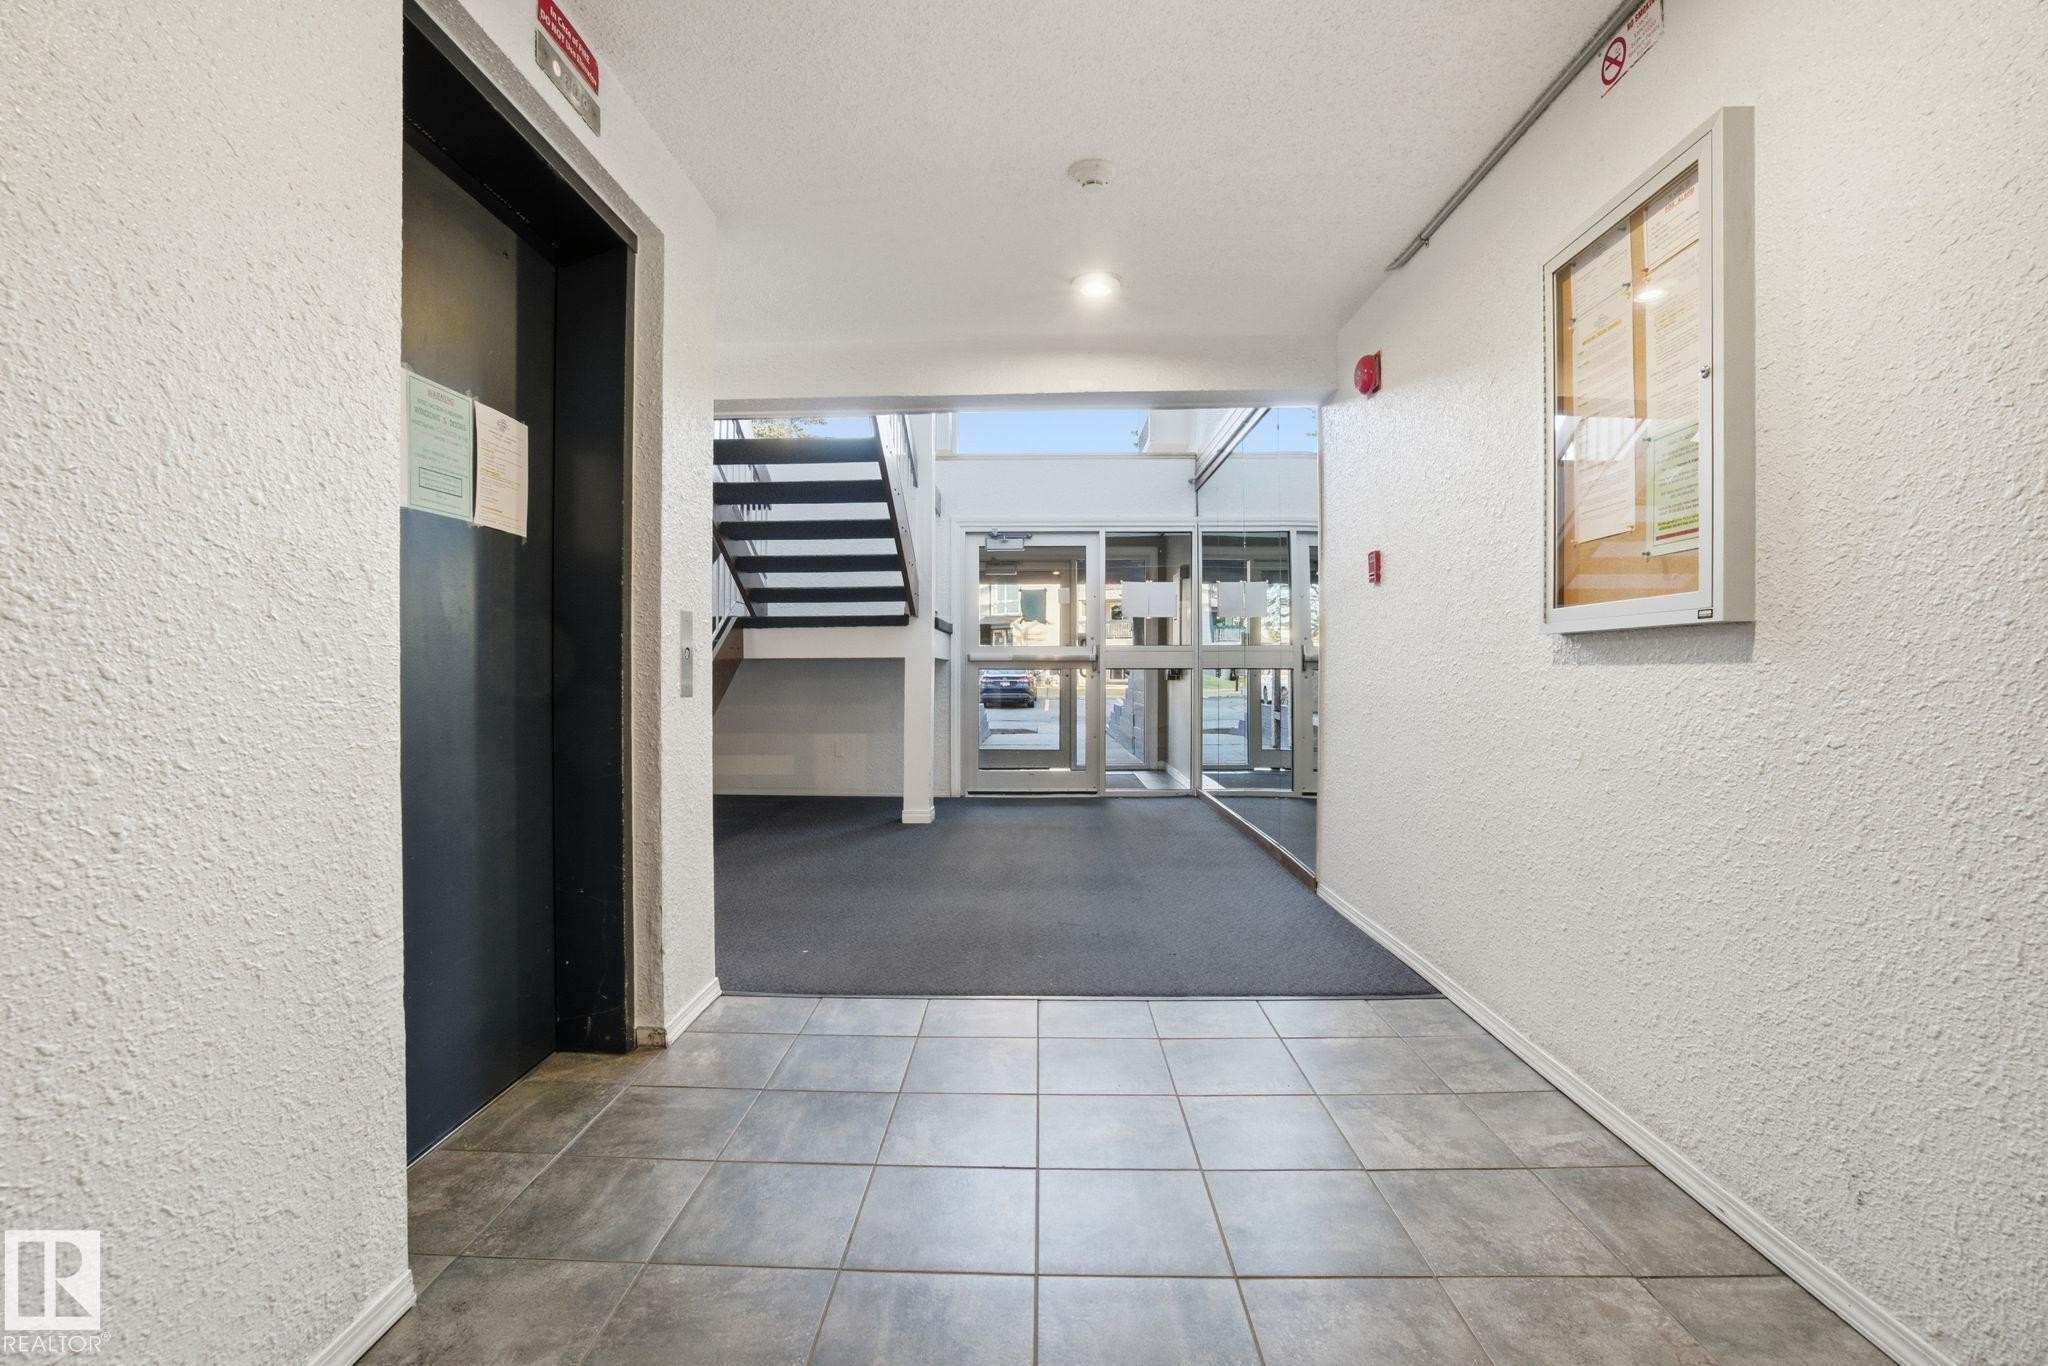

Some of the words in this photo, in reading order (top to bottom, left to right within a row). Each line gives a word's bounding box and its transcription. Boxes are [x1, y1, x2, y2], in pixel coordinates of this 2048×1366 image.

[540, 8, 551, 26] DO
[551, 21, 565, 43] NOT
[565, 39, 577, 58] Use
[557, 17, 572, 40] Case
